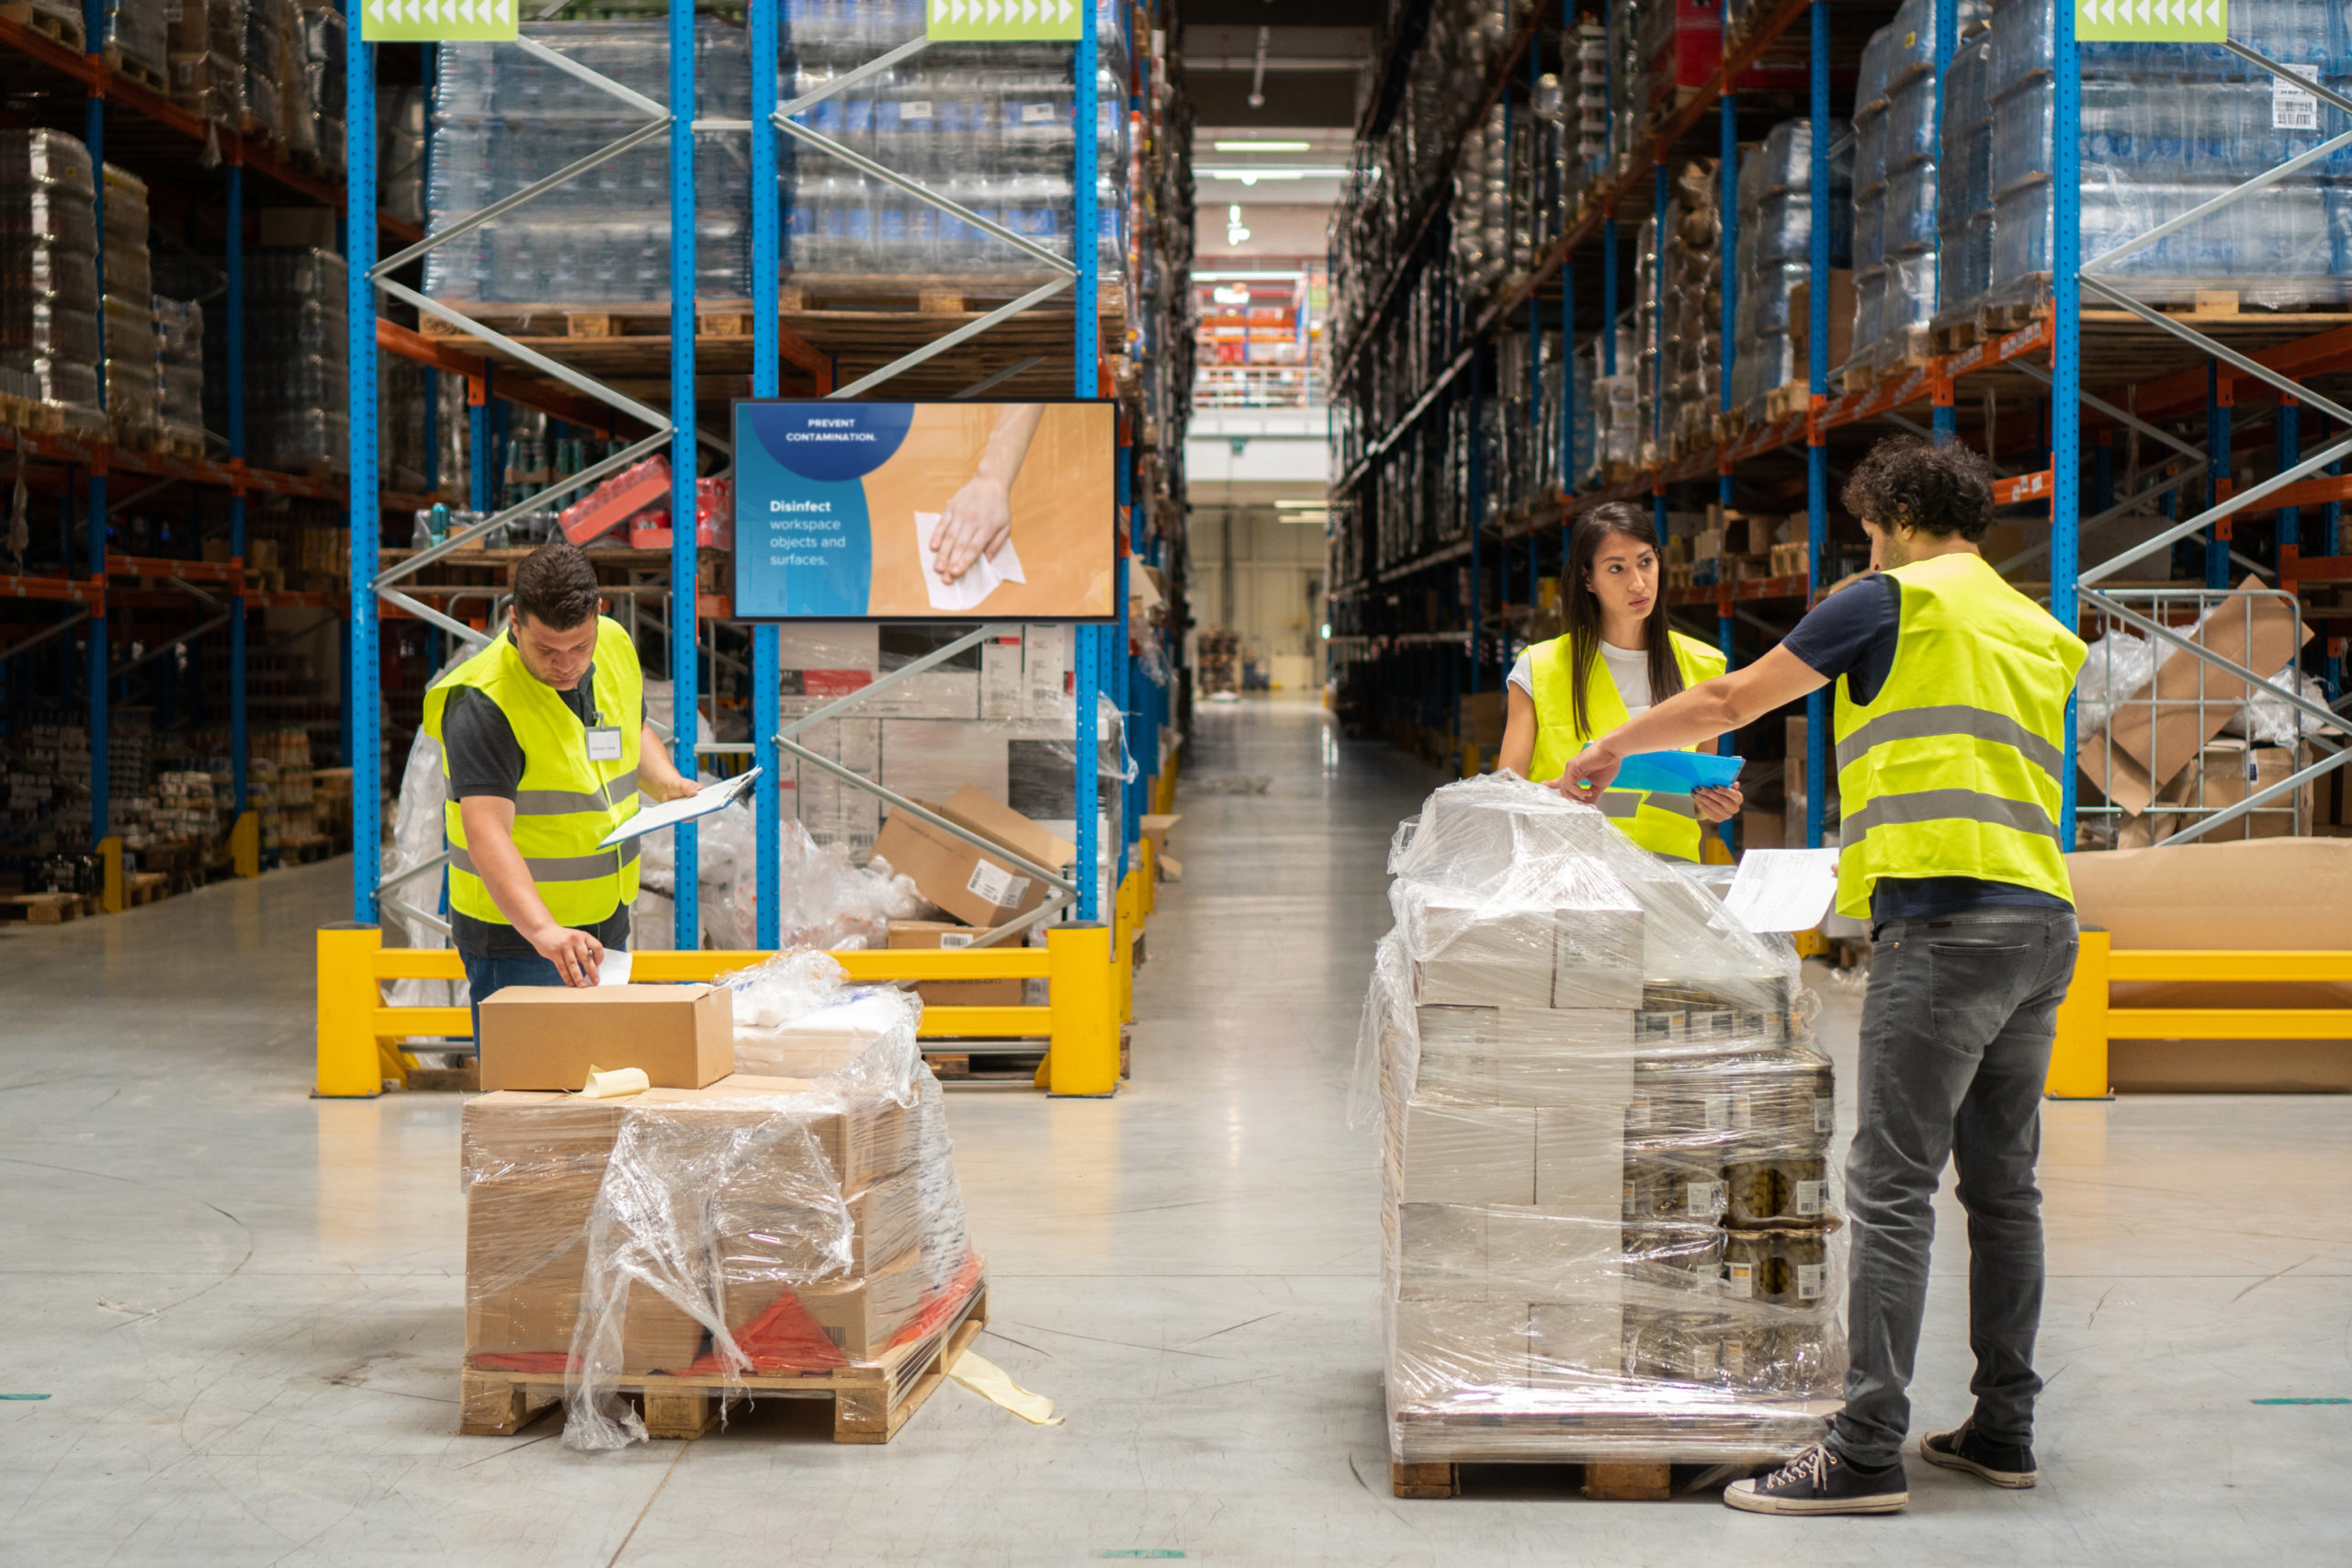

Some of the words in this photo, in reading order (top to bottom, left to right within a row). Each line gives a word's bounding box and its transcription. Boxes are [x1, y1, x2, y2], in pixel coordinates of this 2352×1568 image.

[808, 418, 855, 428] PREVENT
[786, 432, 876, 442] CONTAMINATION.
[770, 501, 831, 513] Disinfect
[770, 518, 841, 533] workspace
[770, 536, 818, 551] objects
[821, 536, 846, 548] and
[770, 553, 828, 566] surfaces.
